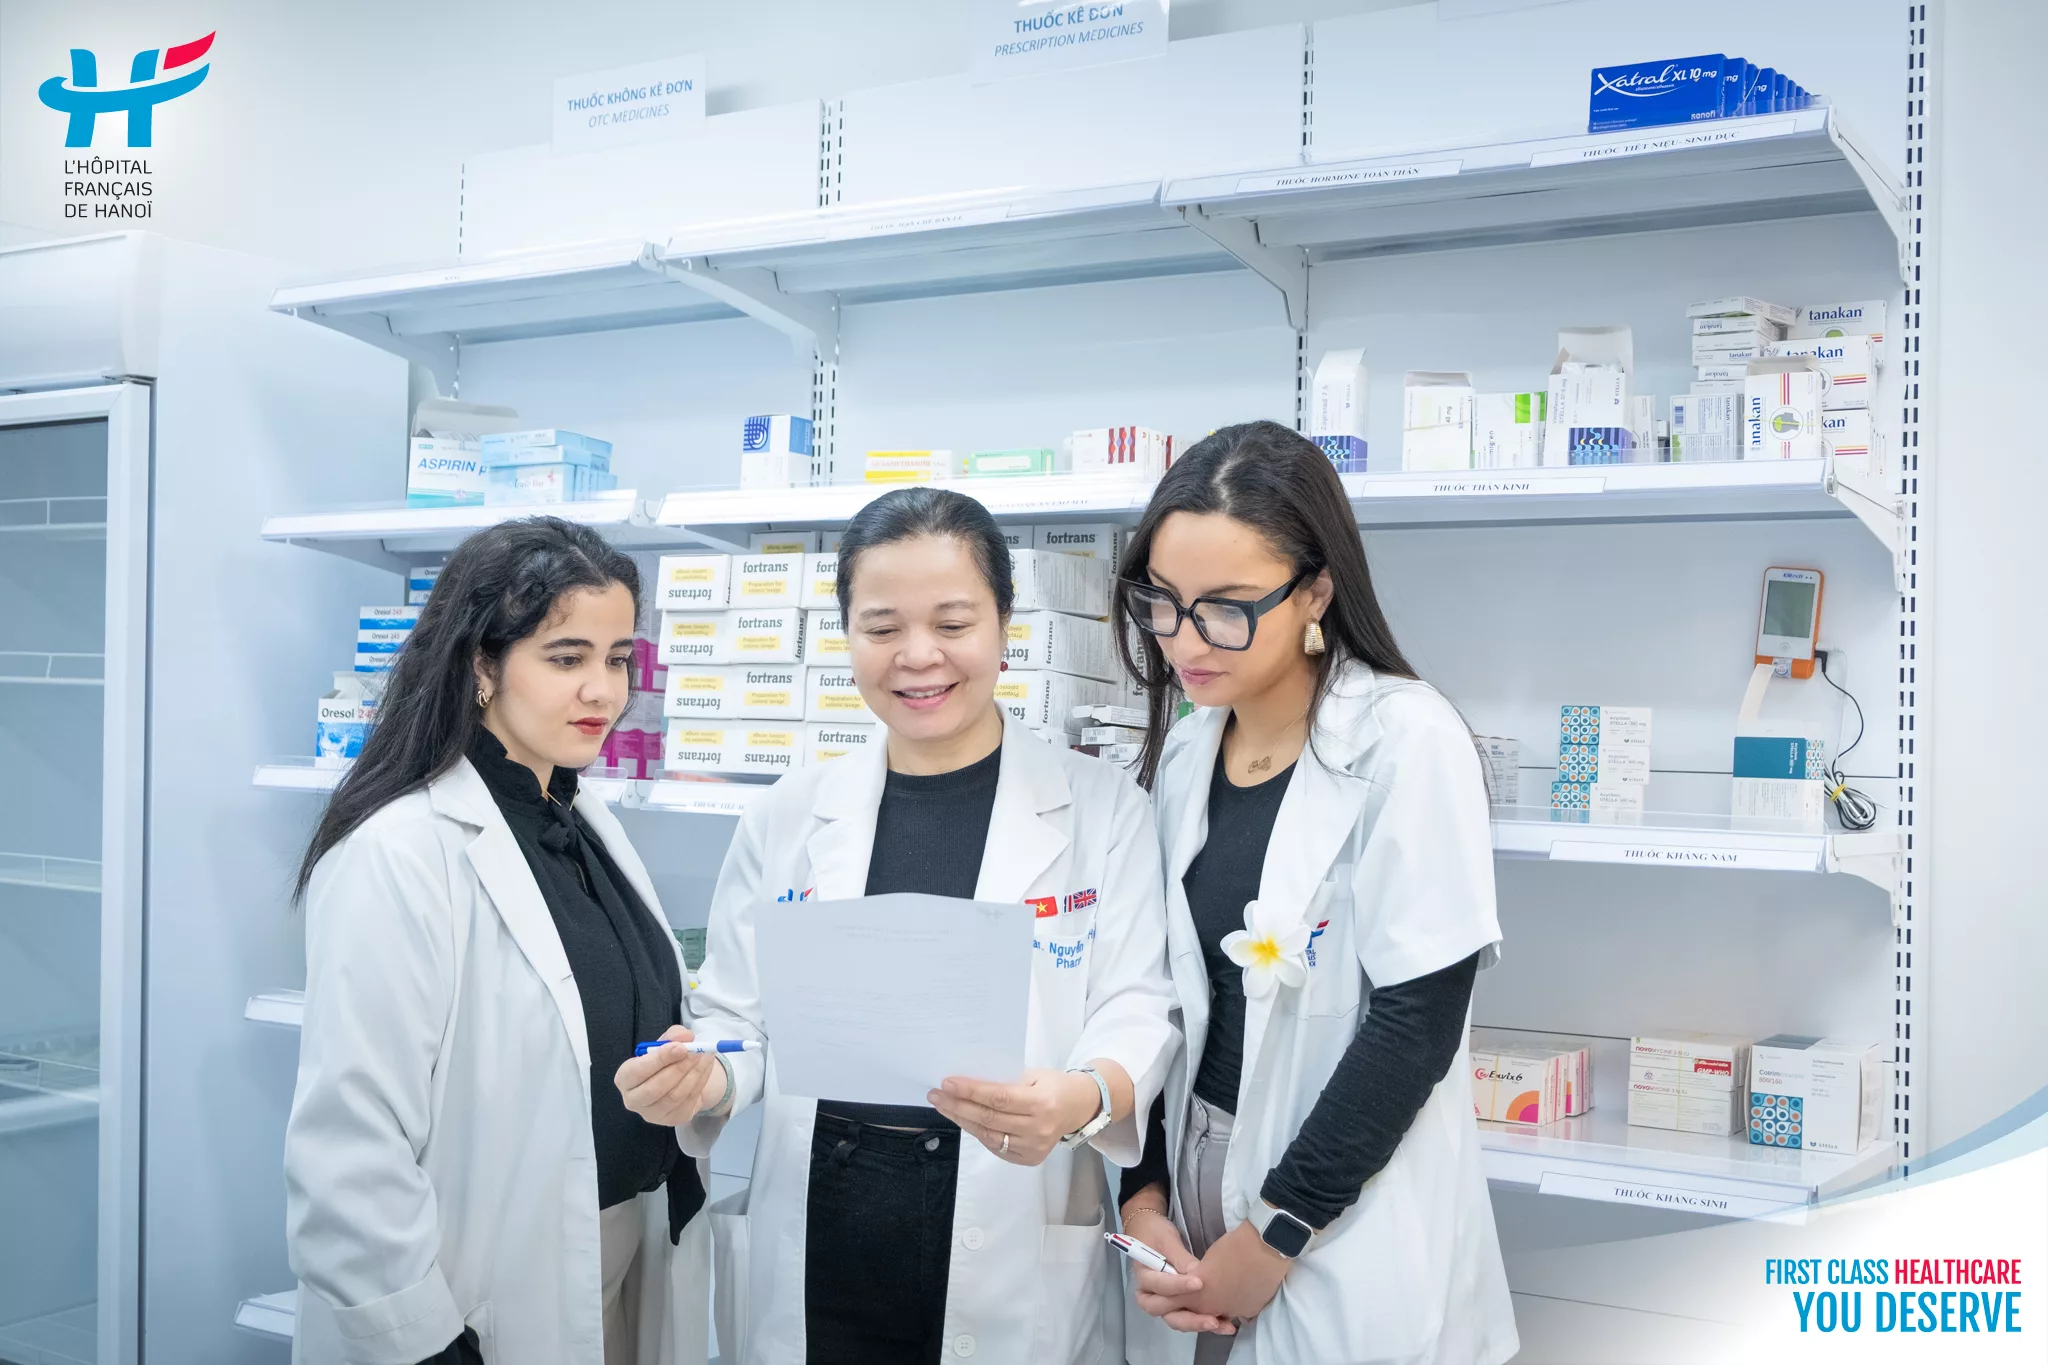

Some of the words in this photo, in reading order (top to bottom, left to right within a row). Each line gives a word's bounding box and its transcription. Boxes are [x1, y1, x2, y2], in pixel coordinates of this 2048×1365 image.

[1014, 10, 1064, 33] THUỐC
[1067, 6, 1084, 25] KÊ
[994, 34, 1075, 57] PRESCRIPTION
[1078, 21, 1144, 43] MEDICINES
[1594, 64, 1675, 97] Xatral
[1672, 70, 1687, 81] XL
[1690, 68, 1701, 80] 10
[1702, 70, 1718, 79] mg
[567, 91, 605, 111] THUỐC
[607, 87, 646, 104] KHÔNG
[649, 81, 663, 97] KÊ
[666, 79, 693, 94] ĐƠN
[588, 113, 609, 128] OTC
[611, 103, 670, 124] MEDICINES
[1691, 110, 1716, 120] sanofi
[1685, 135, 1712, 144] SINH
[1310, 173, 1360, 183] HORMONE
[1809, 307, 1863, 321] tanakan
[418, 458, 477, 472] ASPIRIN
[1046, 532, 1096, 544] fortrans
[743, 561, 788, 573] fortrans
[816, 561, 838, 573] fort
[668, 589, 712, 600] fortrans
[738, 617, 783, 628] fortrans
[819, 618, 842, 630] fort
[795, 617, 804, 658] fortrans
[1046, 620, 1054, 664] fortrans
[669, 645, 713, 656] fortrans
[746, 671, 793, 683] fortrans
[819, 674, 855, 686] fortra
[676, 697, 721, 710] fortrans
[1043, 680, 1051, 724] fortrans
[321, 707, 355, 719] Oresol
[818, 730, 867, 743] fortrans
[678, 751, 721, 764] fortrans
[745, 753, 791, 766] fortrans
[1624, 849, 1663, 858] THUỐC
[1696, 1067, 1730, 1076] GMP-WHO
[1614, 1187, 1654, 1199] THUỐC
[1656, 1193, 1697, 1206] KHÁNG
[1700, 1199, 1728, 1209] SINH
